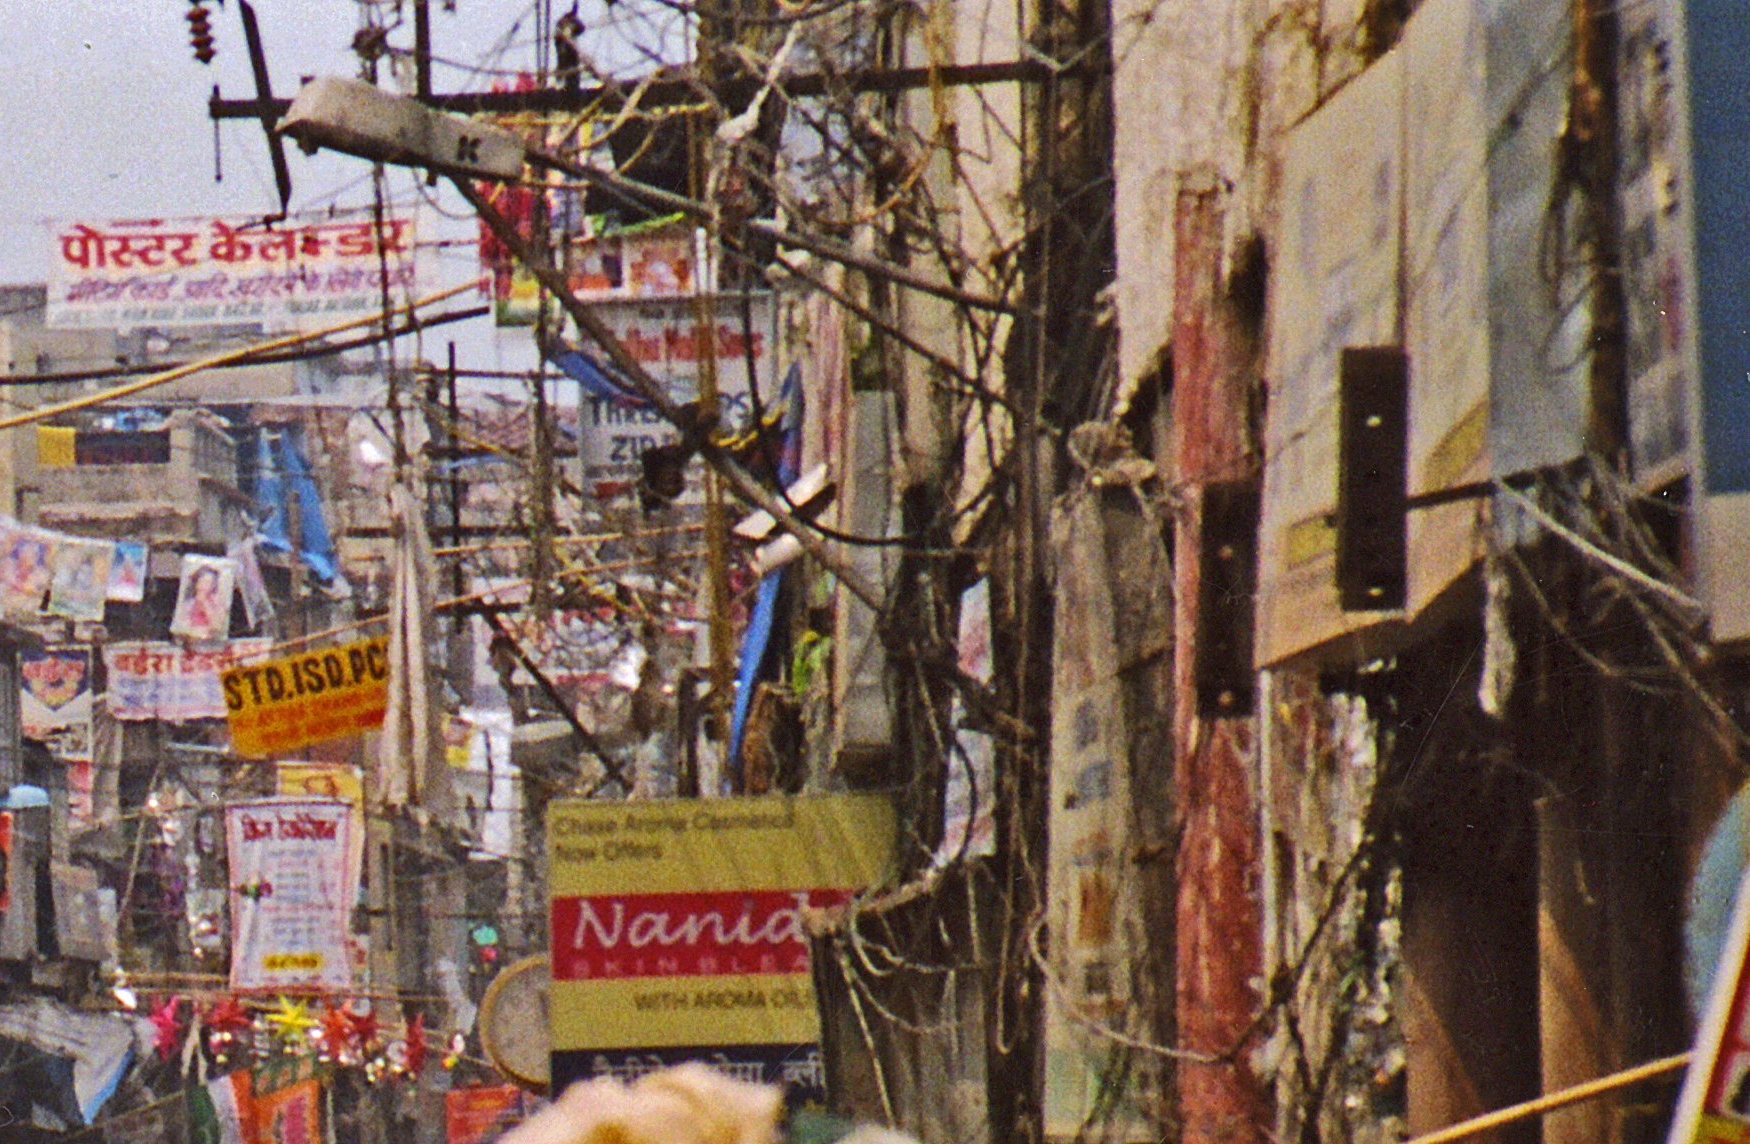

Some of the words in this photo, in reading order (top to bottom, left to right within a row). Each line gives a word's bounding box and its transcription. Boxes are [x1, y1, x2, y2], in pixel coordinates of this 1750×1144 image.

[59, 222, 200, 268] पोस्टर
[222, 636, 395, 712] STD.ISD.PC
[573, 890, 808, 950] Nanid
[698, 953, 810, 978] BLEA
